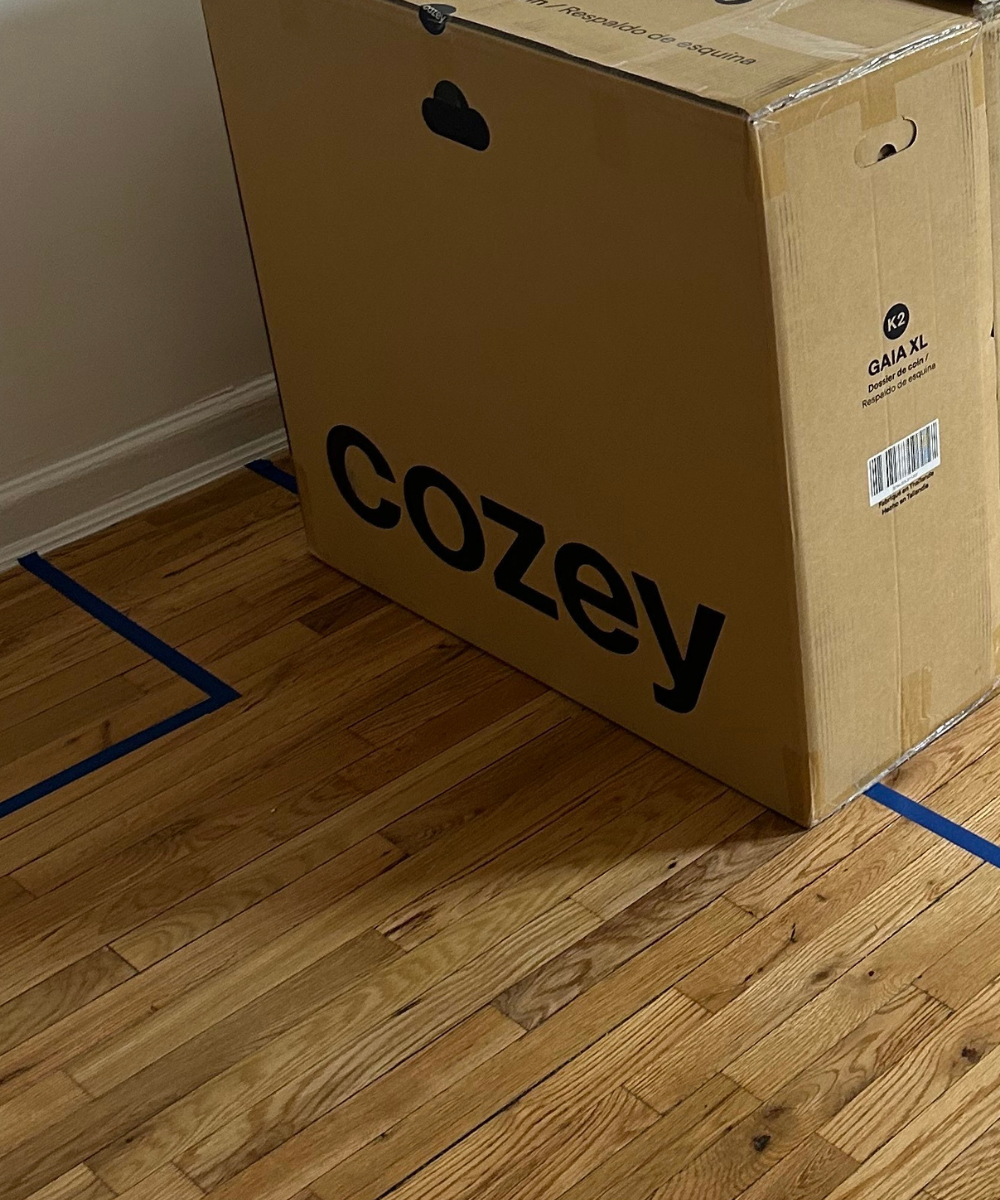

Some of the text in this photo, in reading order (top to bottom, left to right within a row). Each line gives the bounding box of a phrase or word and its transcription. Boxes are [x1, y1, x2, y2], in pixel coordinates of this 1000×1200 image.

[422, 5, 447, 23] cozey
[559, 6, 648, 36] Respaldo
[648, 32, 676, 44] de
[676, 41, 757, 66] esquina
[887, 312, 906, 332] K2
[868, 334, 928, 376] GAIA XL
[868, 353, 929, 393] Dossier de coin /
[862, 362, 936, 409] Respaldo de esquina
[326, 424, 726, 714] cozey
